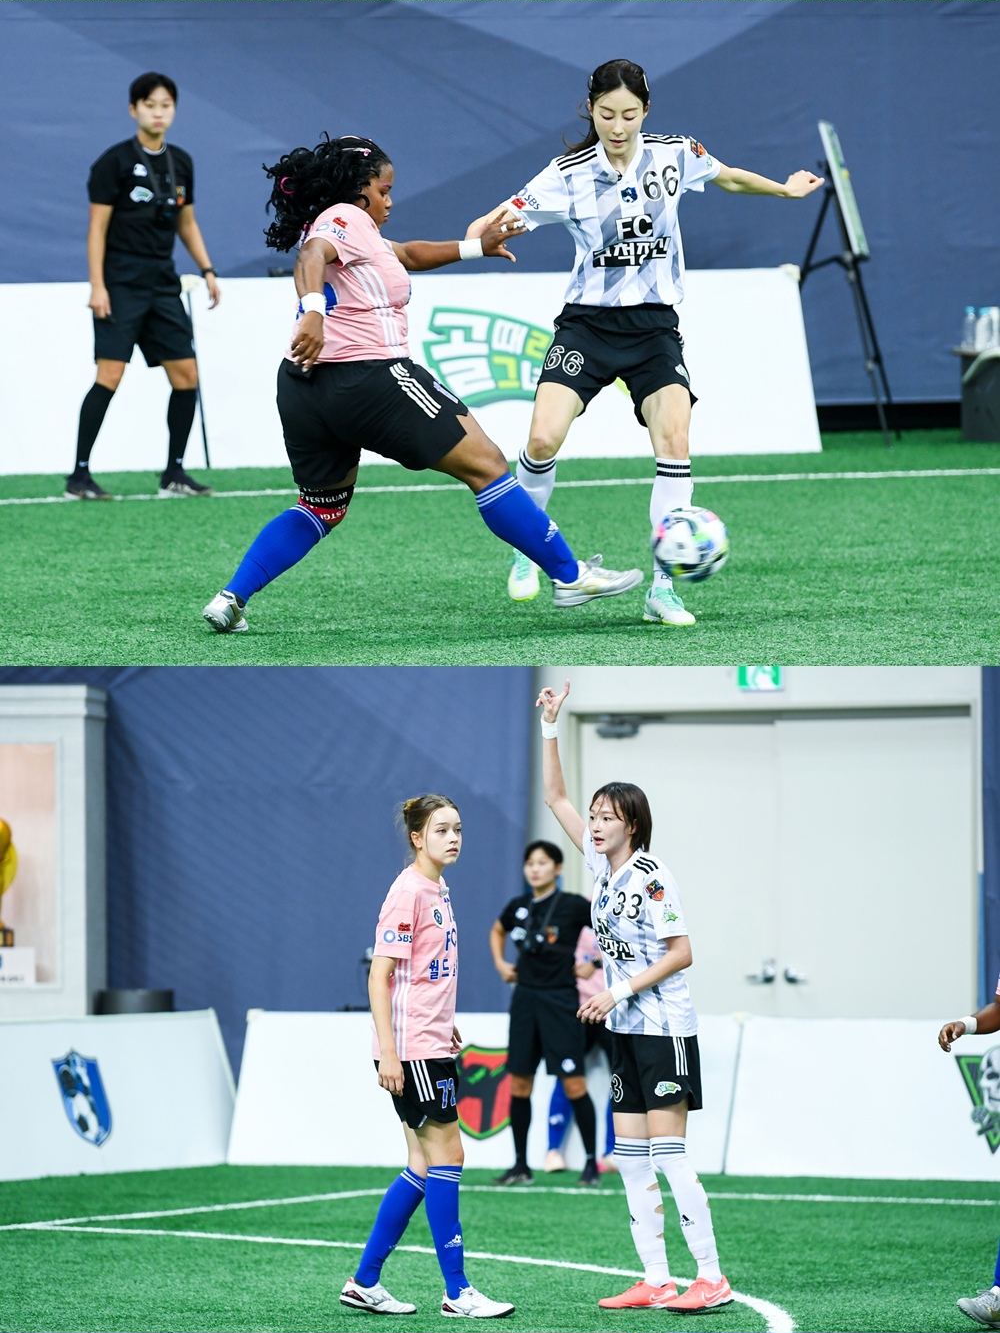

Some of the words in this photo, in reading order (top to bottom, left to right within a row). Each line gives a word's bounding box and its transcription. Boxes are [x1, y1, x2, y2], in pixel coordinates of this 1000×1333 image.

[643, 165, 679, 200] 66
[616, 215, 652, 241] FC
[545, 345, 584, 376] 66
[613, 891, 643, 919] 33
[397, 933, 412, 943] SBS
